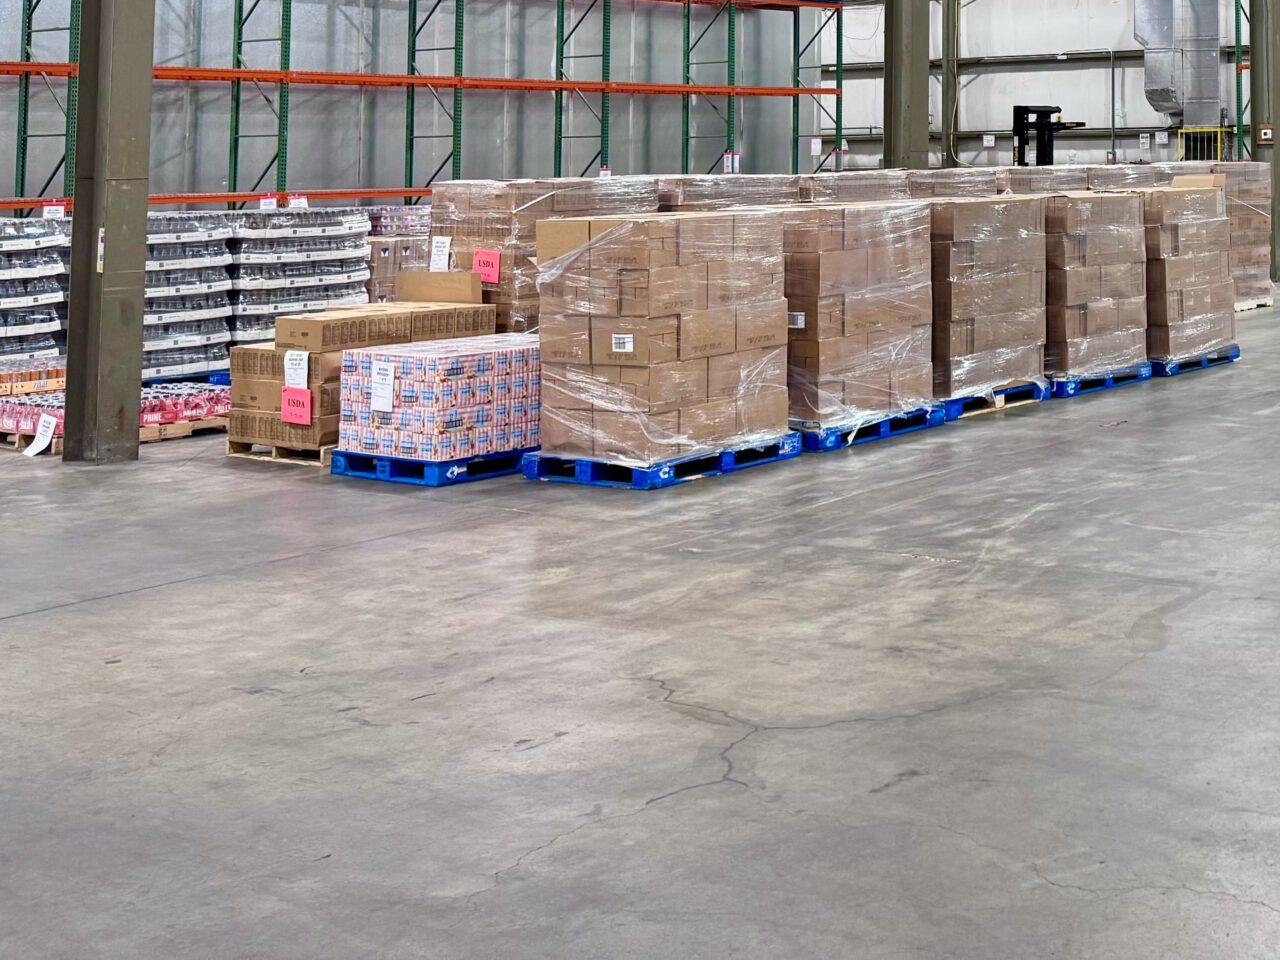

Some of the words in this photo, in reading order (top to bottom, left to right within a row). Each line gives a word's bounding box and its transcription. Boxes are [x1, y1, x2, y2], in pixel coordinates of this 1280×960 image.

[478, 259, 495, 269] USDA
[287, 398, 306, 409] USDA
[143, 412, 162, 423] PRIME
